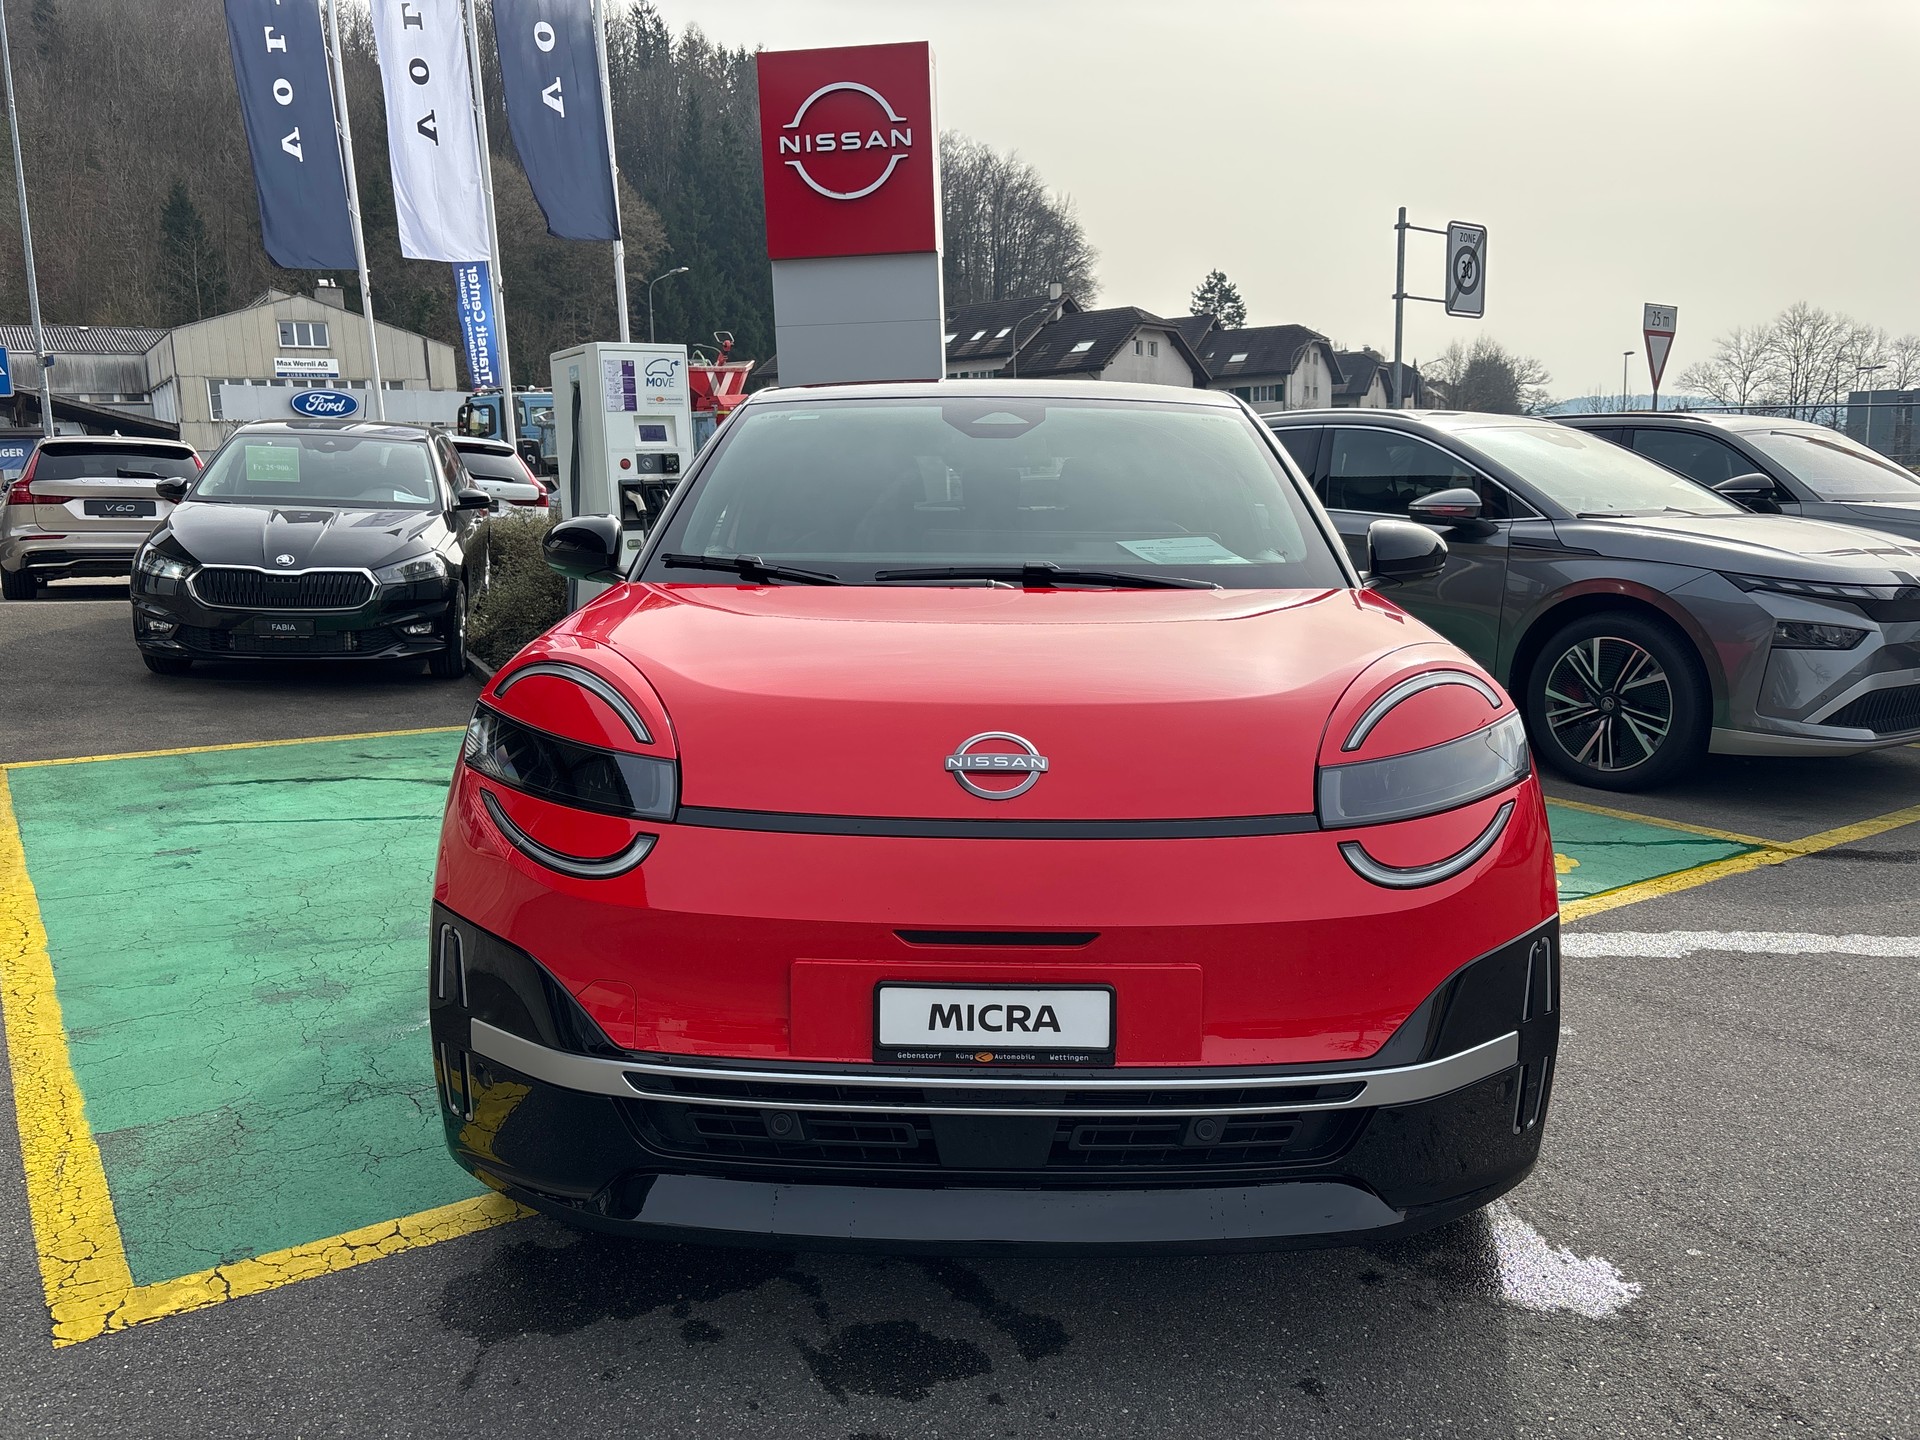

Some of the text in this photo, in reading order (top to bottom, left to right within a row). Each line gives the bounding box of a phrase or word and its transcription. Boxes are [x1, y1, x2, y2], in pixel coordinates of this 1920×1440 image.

[779, 128, 912, 154] NISSAN
[1459, 232, 1476, 244] ZONE
[1461, 260, 1473, 279] 30
[1651, 310, 1670, 327] 25 m
[293, 360, 316, 368] Wernli
[646, 377, 674, 387] MOVE
[306, 393, 346, 412] Ford
[105, 504, 136, 512] V60
[271, 623, 296, 631] FABIA
[948, 756, 1046, 769] NISSAN
[928, 1003, 1062, 1033] MICRA
[897, 1051, 942, 1059] Gebenstorf
[1049, 1054, 1089, 1062] Wettingen
